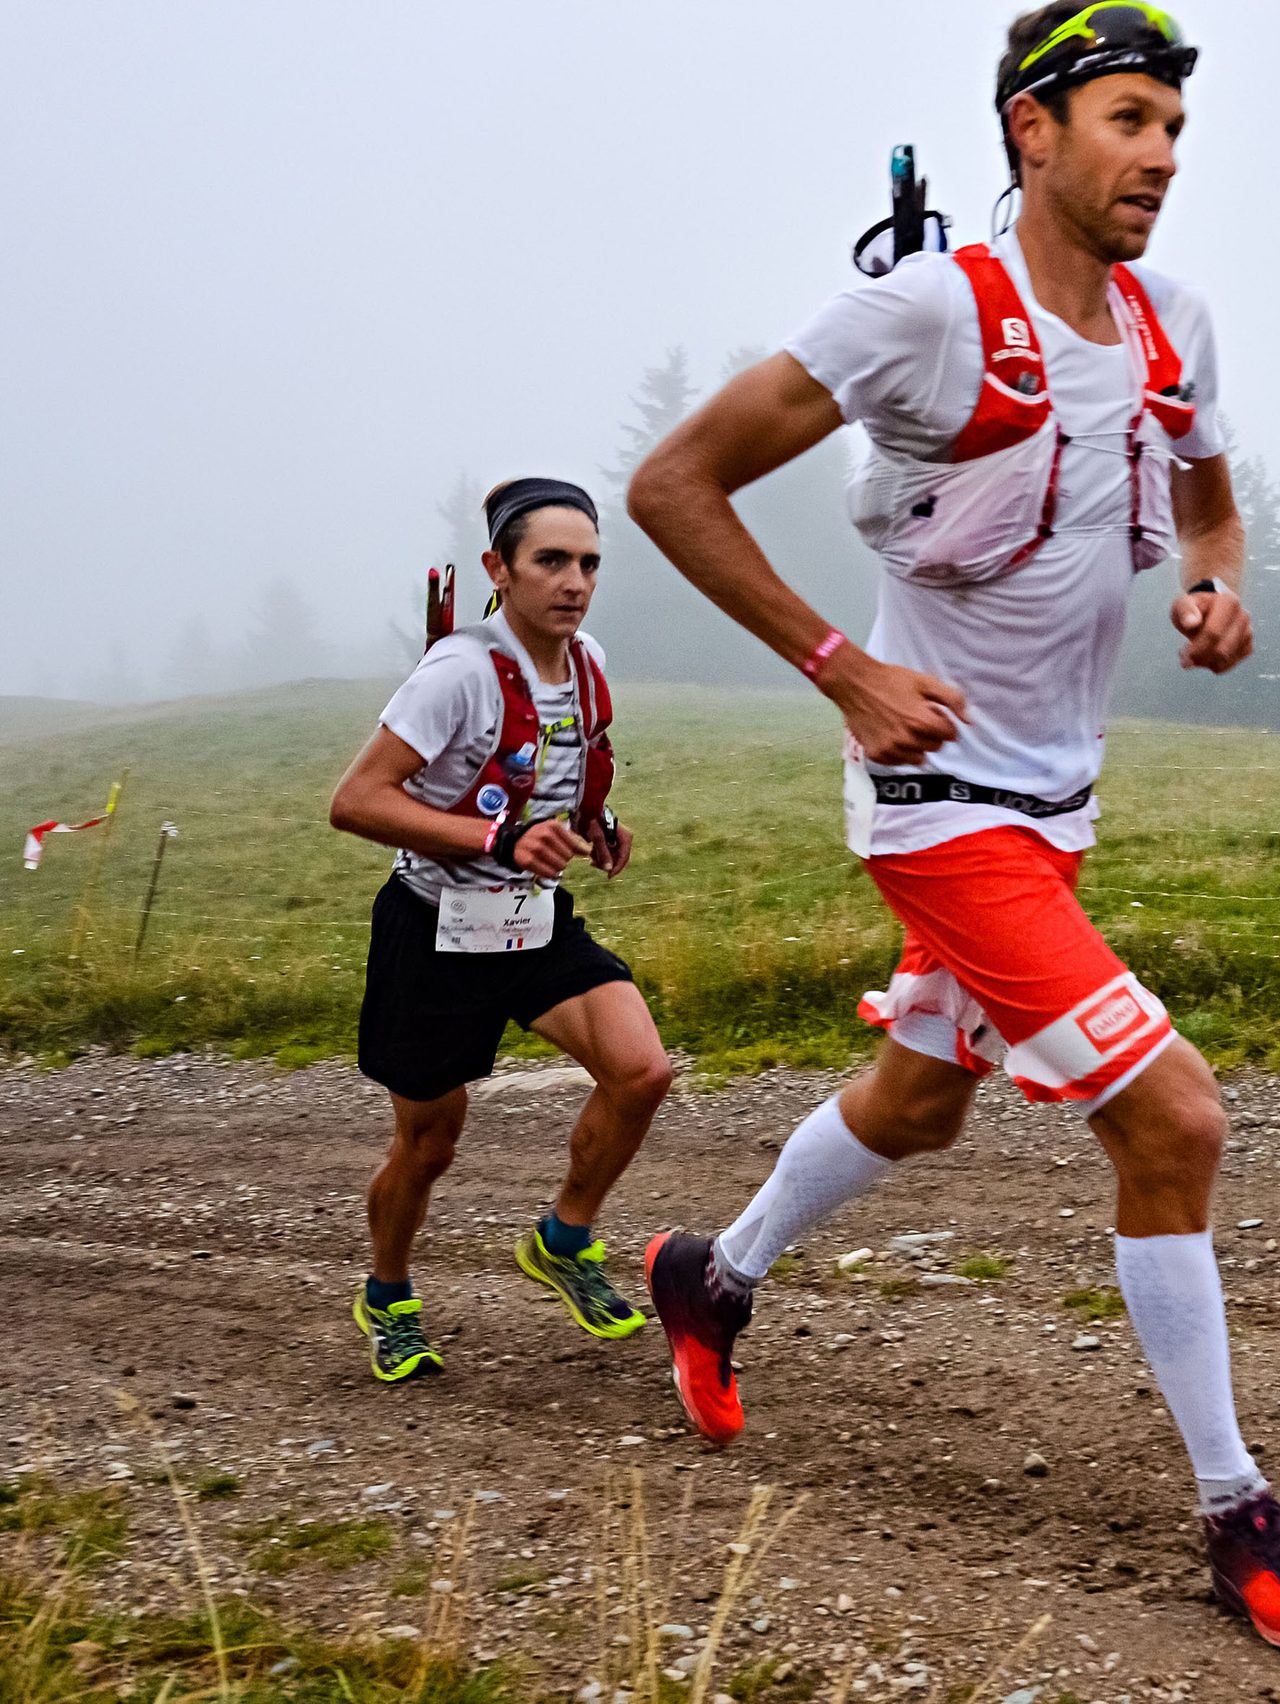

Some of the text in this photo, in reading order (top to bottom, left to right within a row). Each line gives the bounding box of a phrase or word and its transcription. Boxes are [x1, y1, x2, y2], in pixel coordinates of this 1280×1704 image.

[880, 781, 922, 799] on
[513, 894, 528, 915] 7
[503, 916, 531, 927] Xavier
